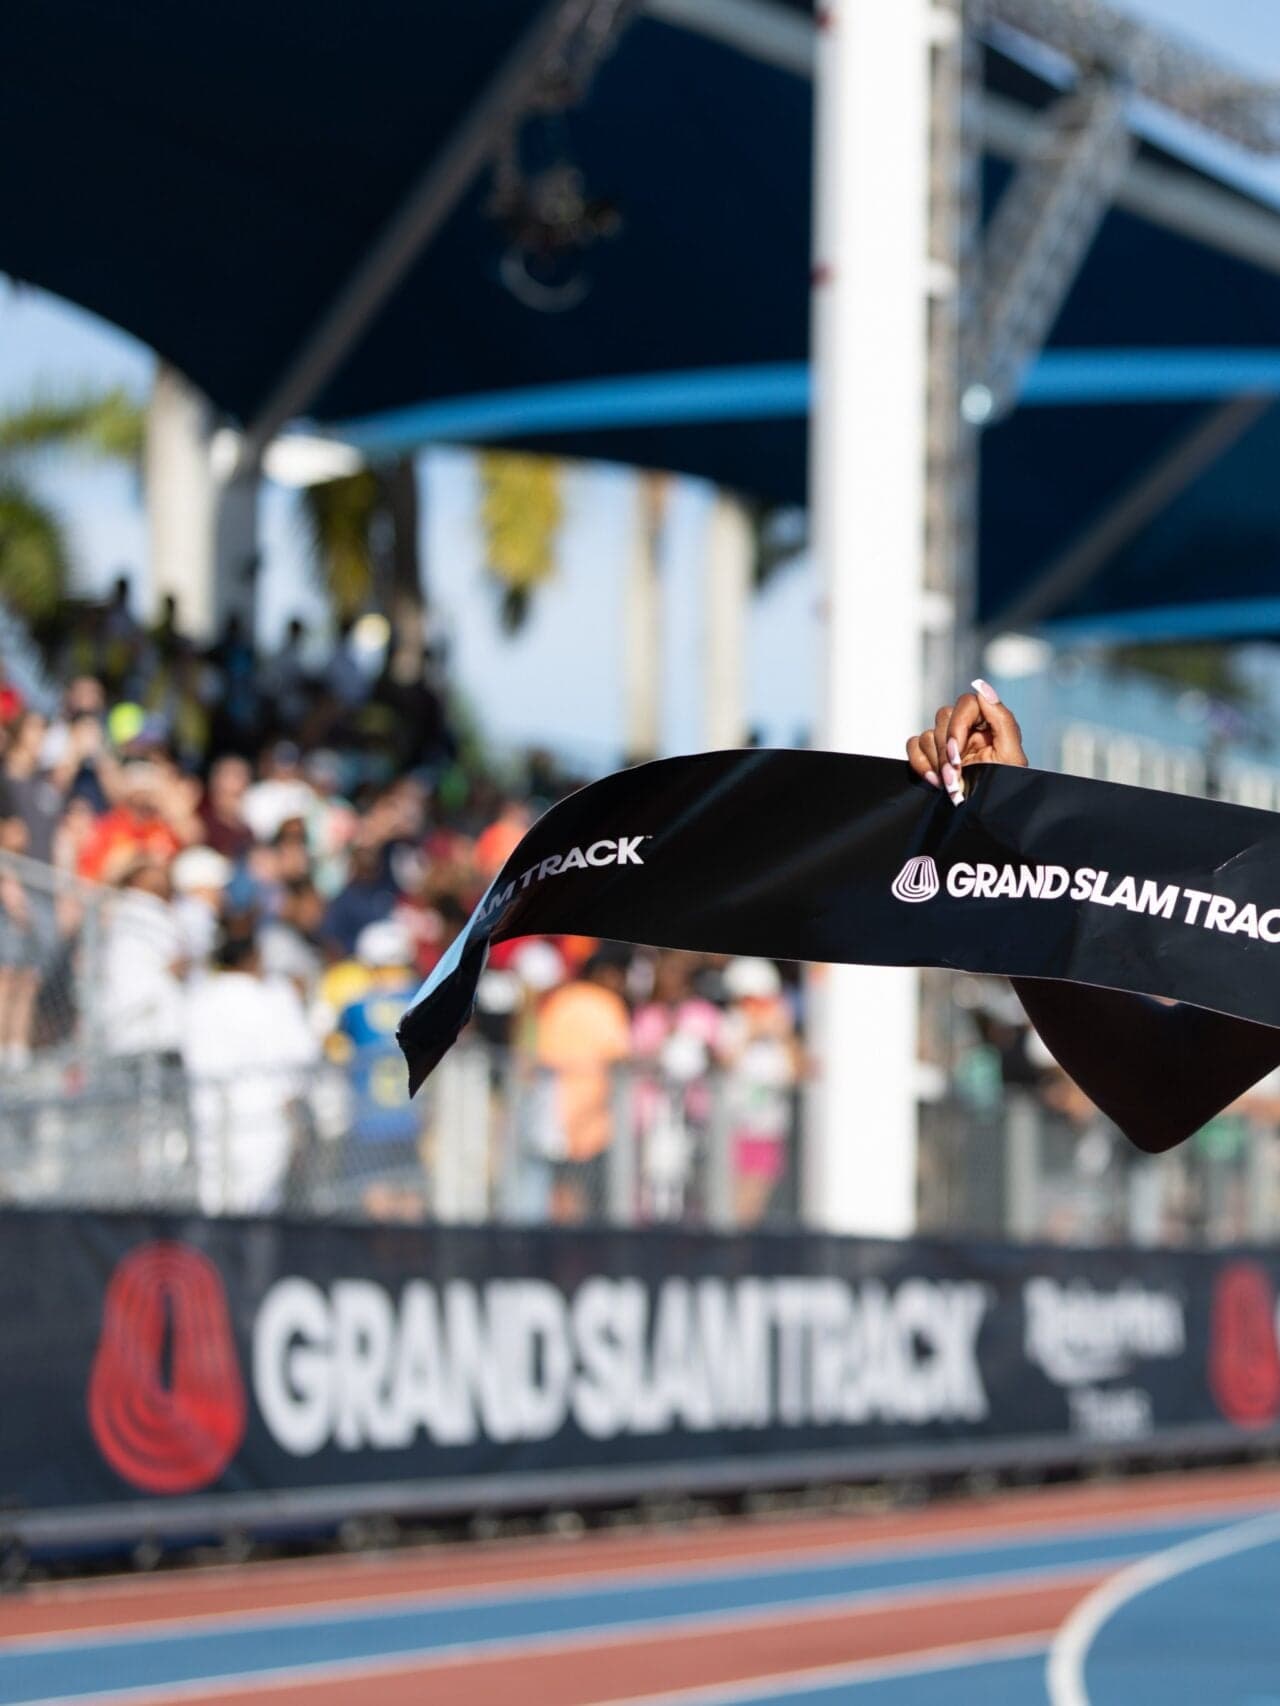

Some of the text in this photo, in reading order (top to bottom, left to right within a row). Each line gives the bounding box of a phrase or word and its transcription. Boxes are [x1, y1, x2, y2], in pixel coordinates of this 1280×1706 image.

[520, 835, 645, 888] TRACK
[946, 862, 1071, 900] GRAND
[1070, 868, 1182, 919] SLAM
[254, 1276, 570, 1456] GRAND
[571, 1275, 765, 1440] SLAM
[765, 1275, 990, 1426] TRACK
